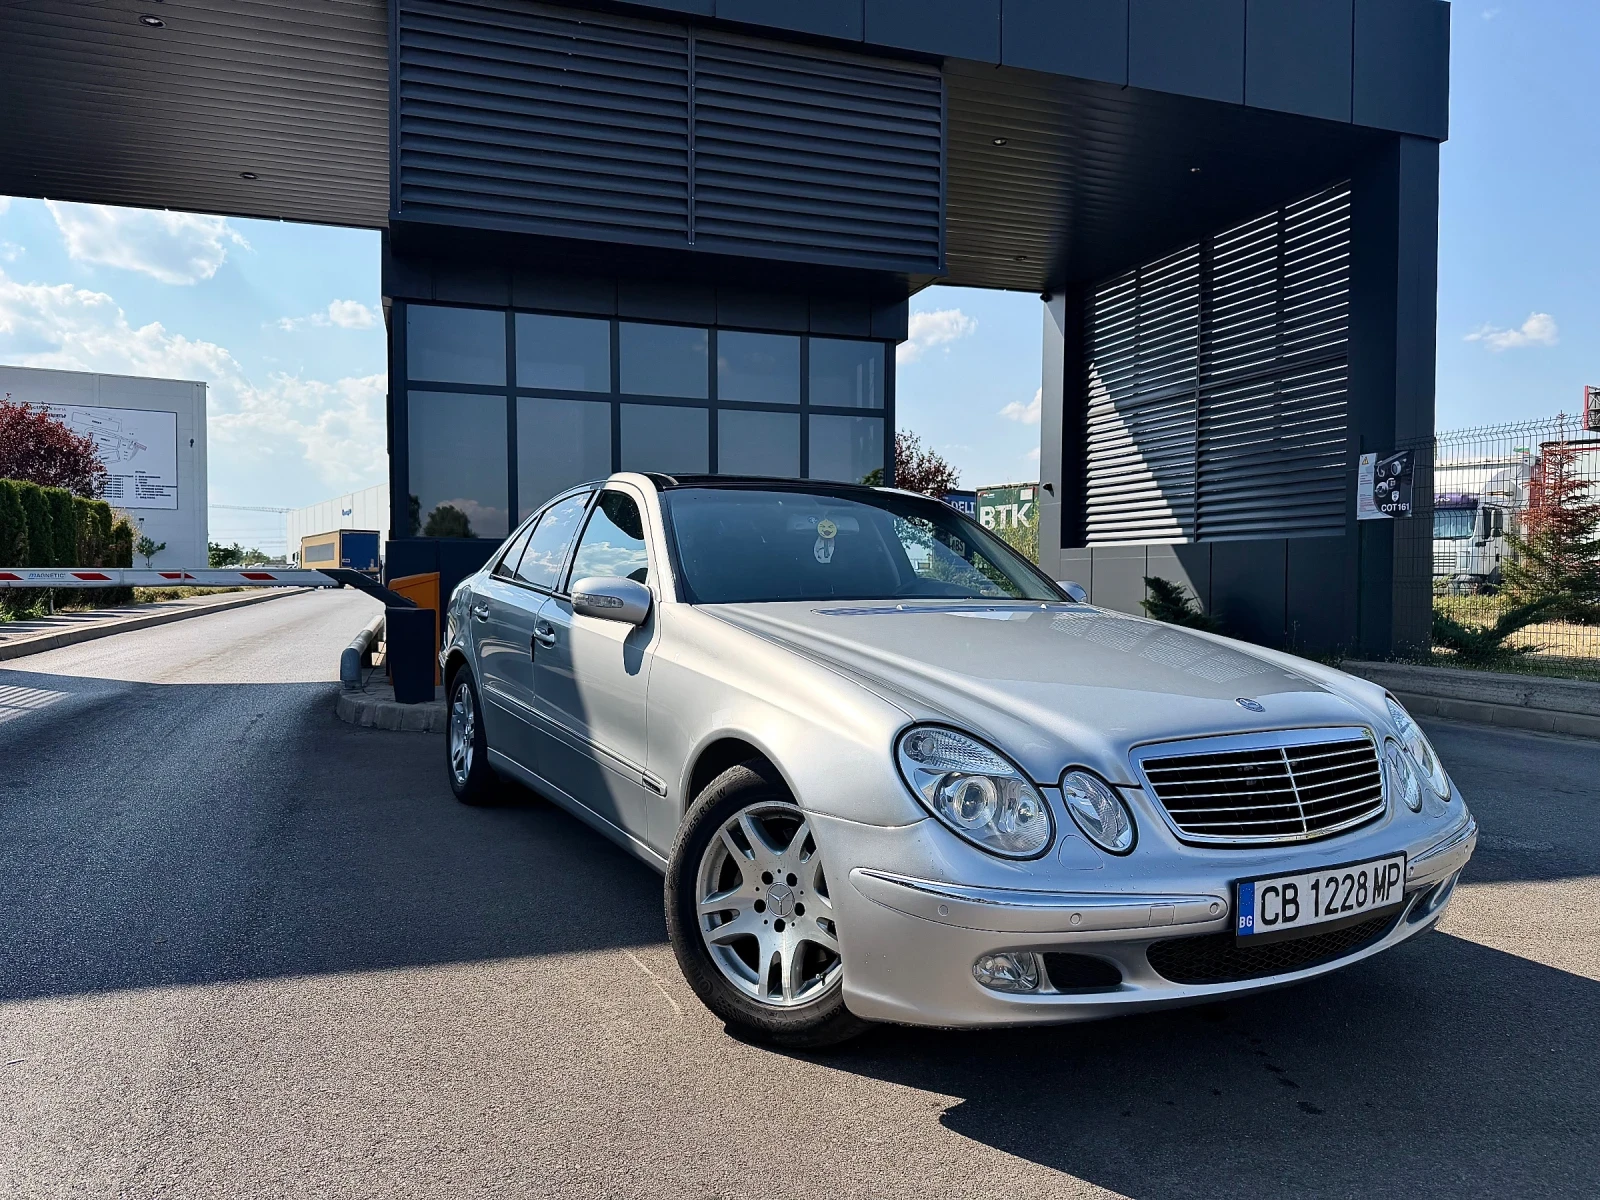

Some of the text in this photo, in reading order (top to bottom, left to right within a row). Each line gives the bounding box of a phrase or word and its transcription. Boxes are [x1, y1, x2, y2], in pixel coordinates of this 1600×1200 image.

[980, 503, 1033, 530] BTK
[1260, 863, 1400, 926] CB 1228 MP
[1239, 916, 1253, 929] BG
